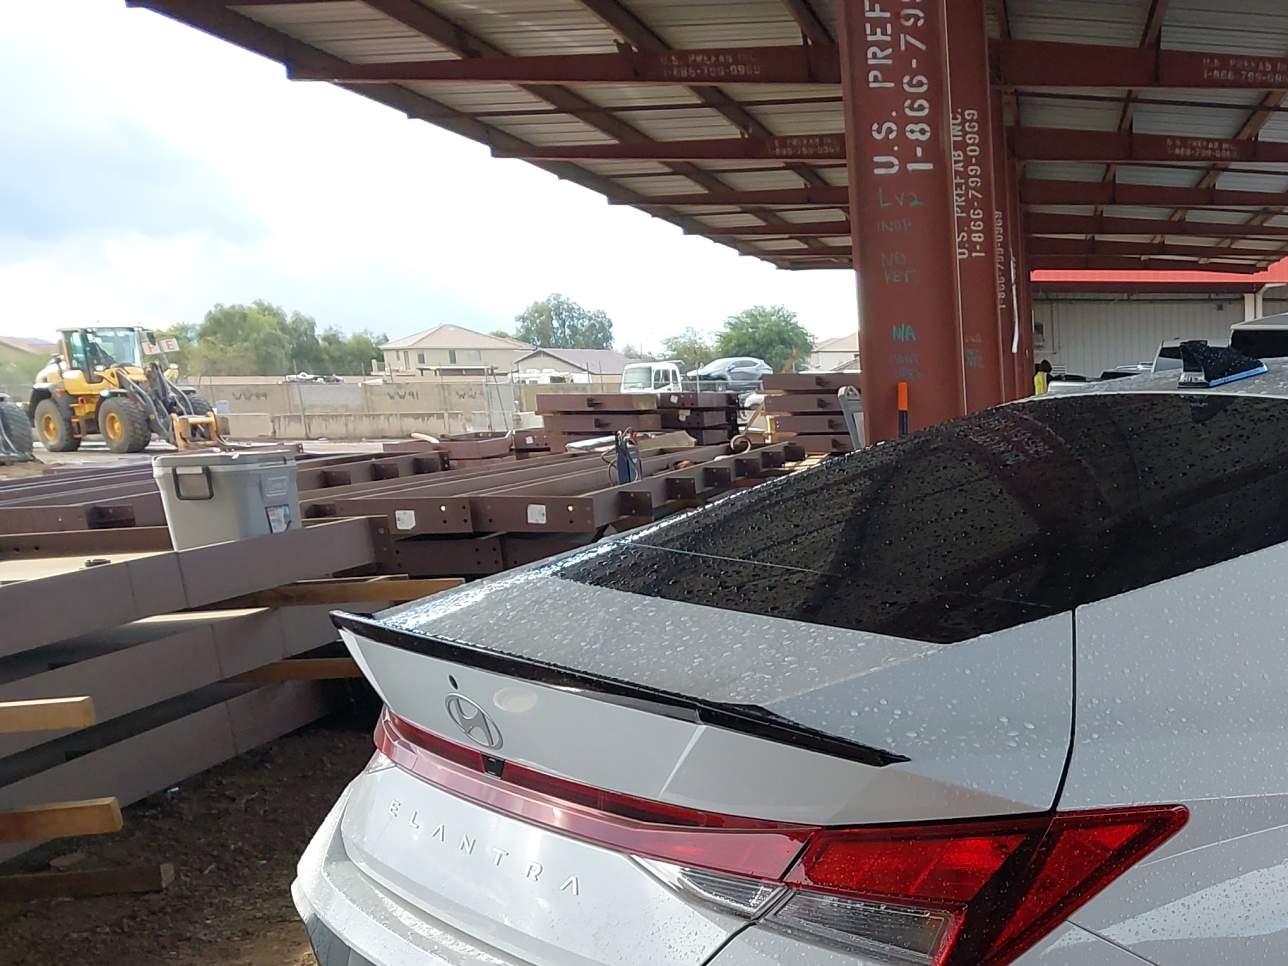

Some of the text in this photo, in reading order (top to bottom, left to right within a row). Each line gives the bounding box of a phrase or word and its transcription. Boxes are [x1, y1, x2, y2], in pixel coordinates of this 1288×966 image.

[871, 110, 900, 175] U.S.
[899, 0, 934, 170] 1-866-79
[964, 109, 985, 257] 1-866-799-0969
[389, 799, 582, 896] ELANTRA
